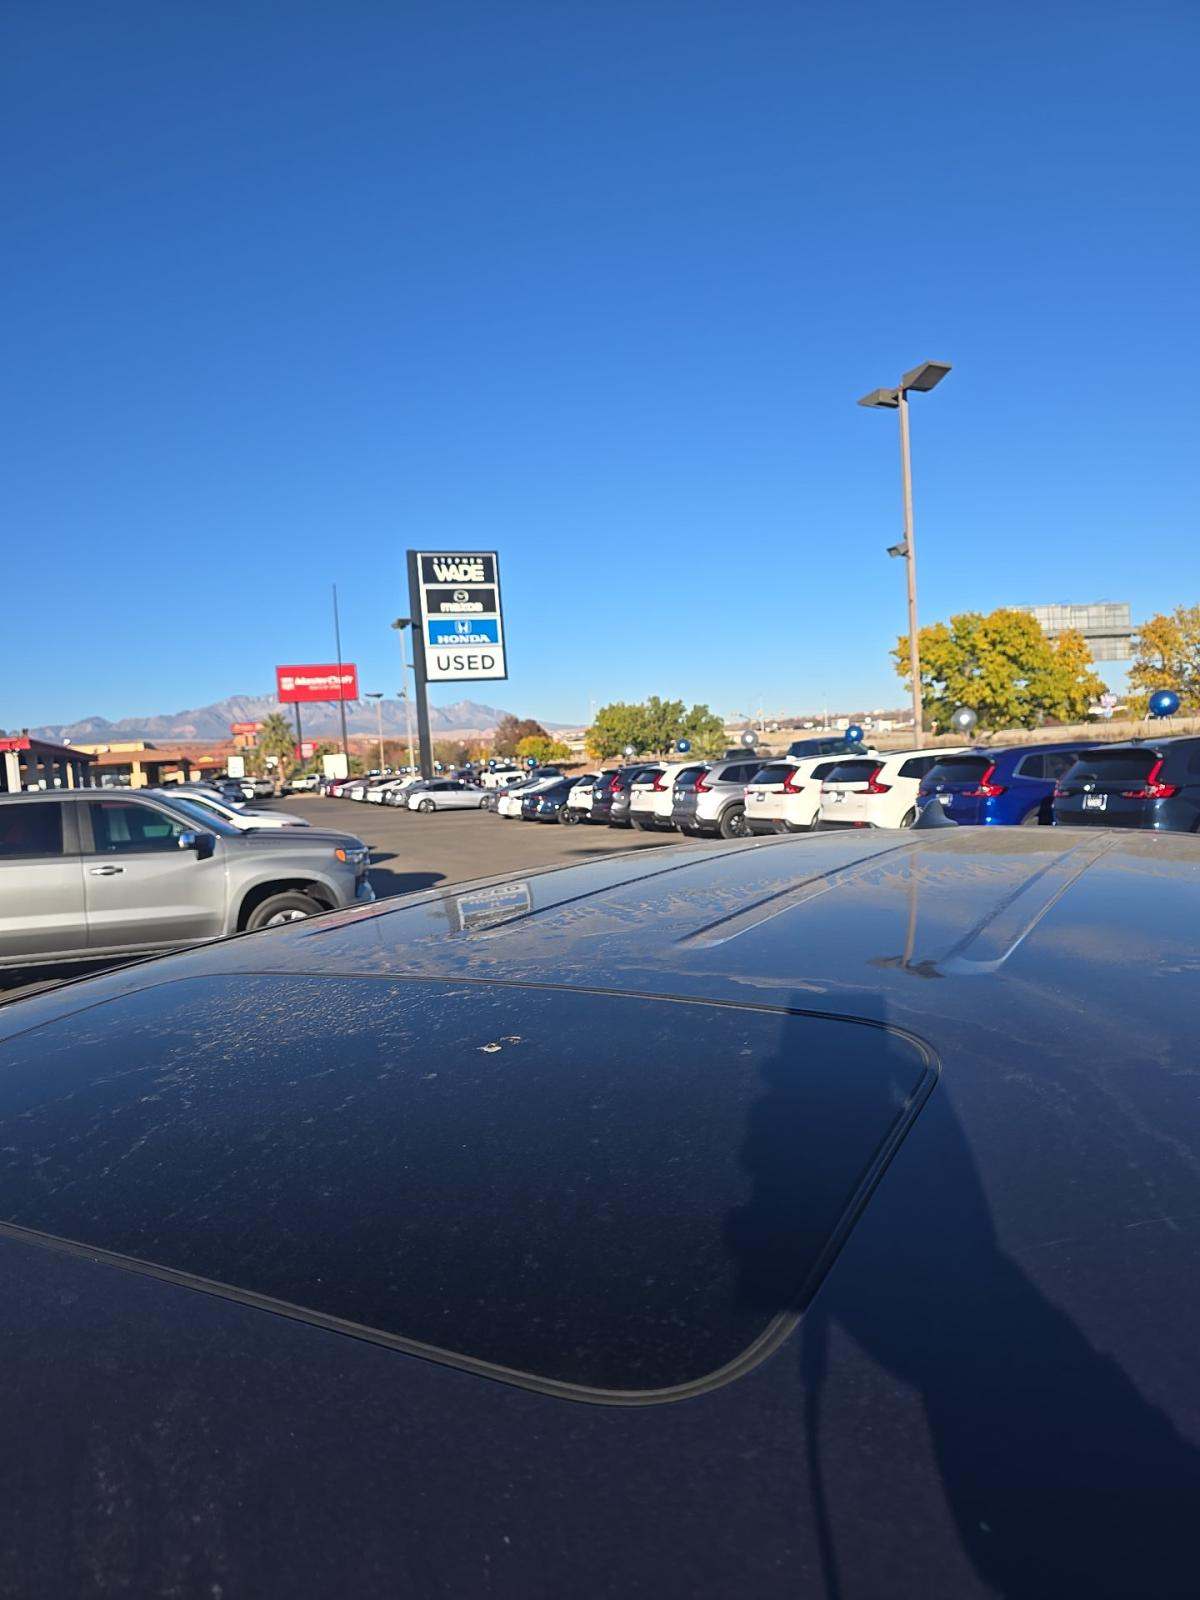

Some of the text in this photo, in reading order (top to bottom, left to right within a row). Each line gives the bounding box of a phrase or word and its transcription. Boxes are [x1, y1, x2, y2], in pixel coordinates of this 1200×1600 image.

[433, 564, 485, 582] WADE
[437, 634, 491, 644] HONDA
[437, 655, 495, 671] USED
